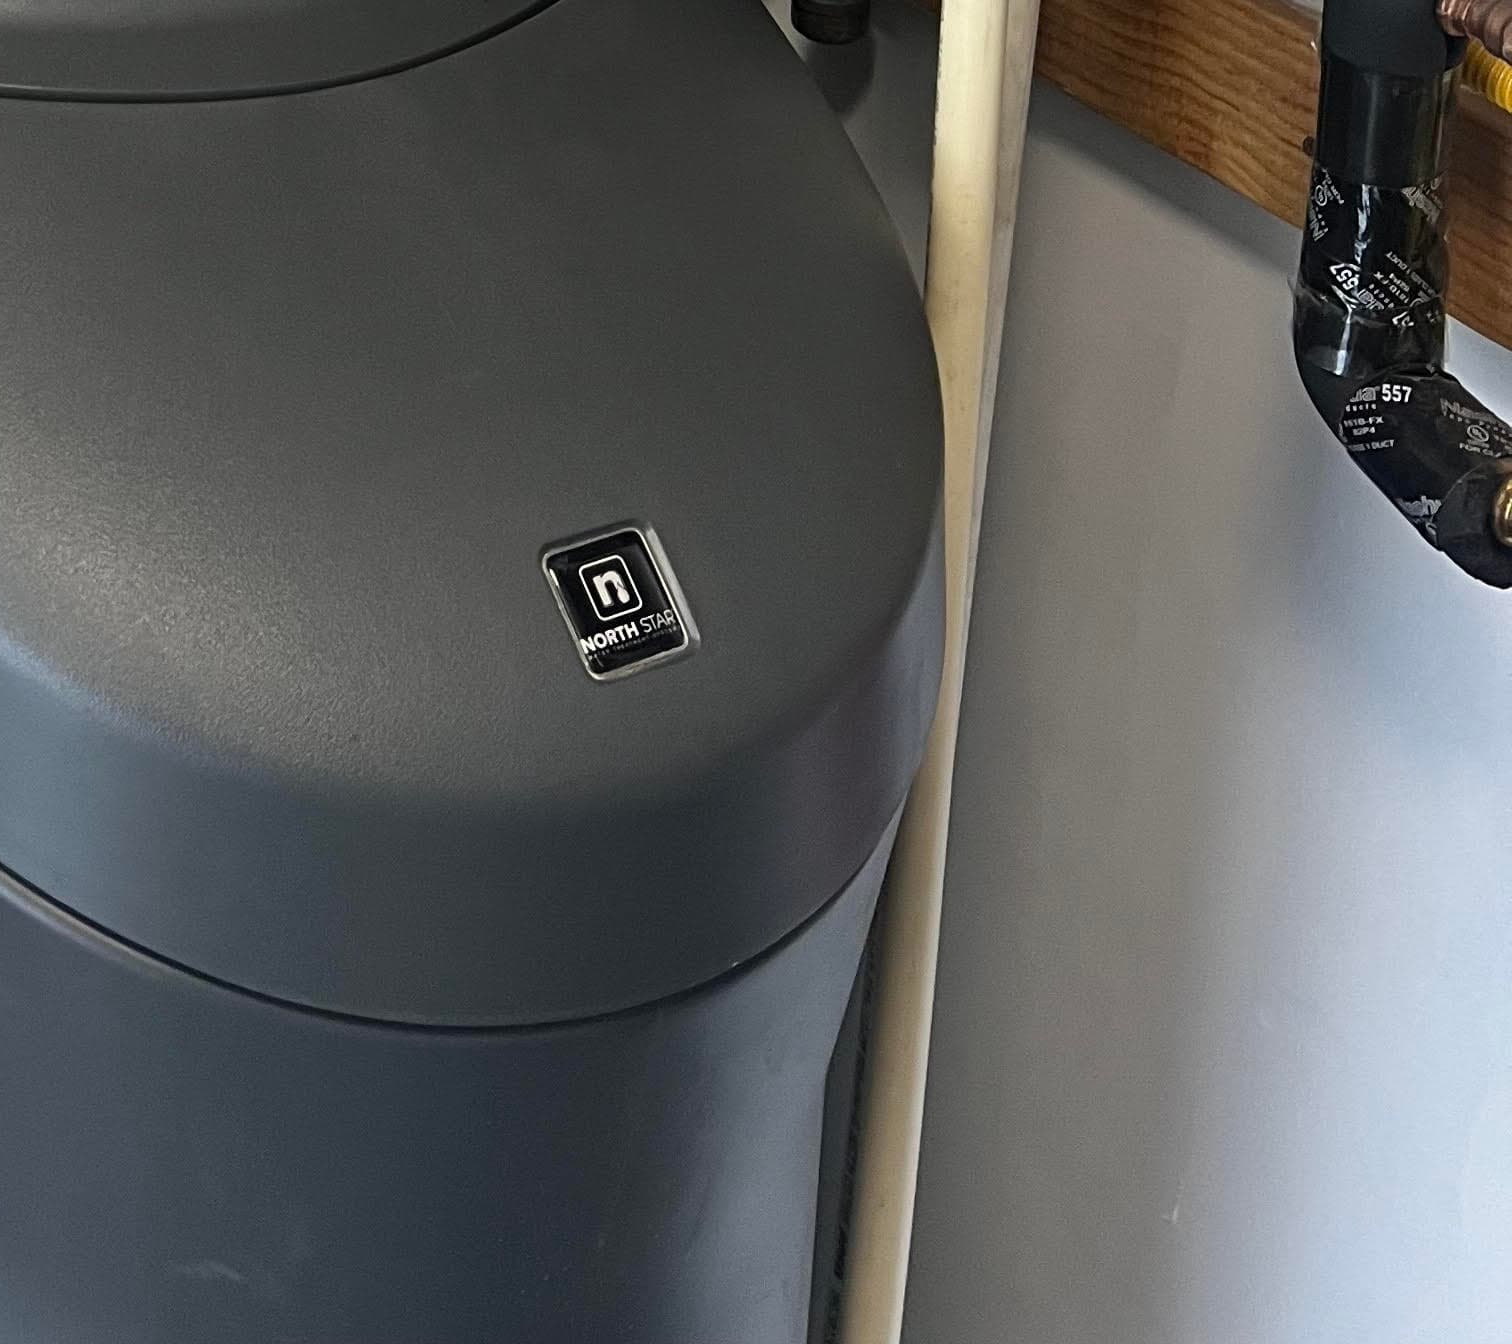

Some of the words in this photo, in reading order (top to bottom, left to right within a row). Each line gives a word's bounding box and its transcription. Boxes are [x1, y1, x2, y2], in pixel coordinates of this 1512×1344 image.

[1381, 383, 1413, 403] 557
[1371, 439, 1395, 450] DUCT
[579, 621, 640, 655] NORTH
[639, 608, 677, 634] STAR
